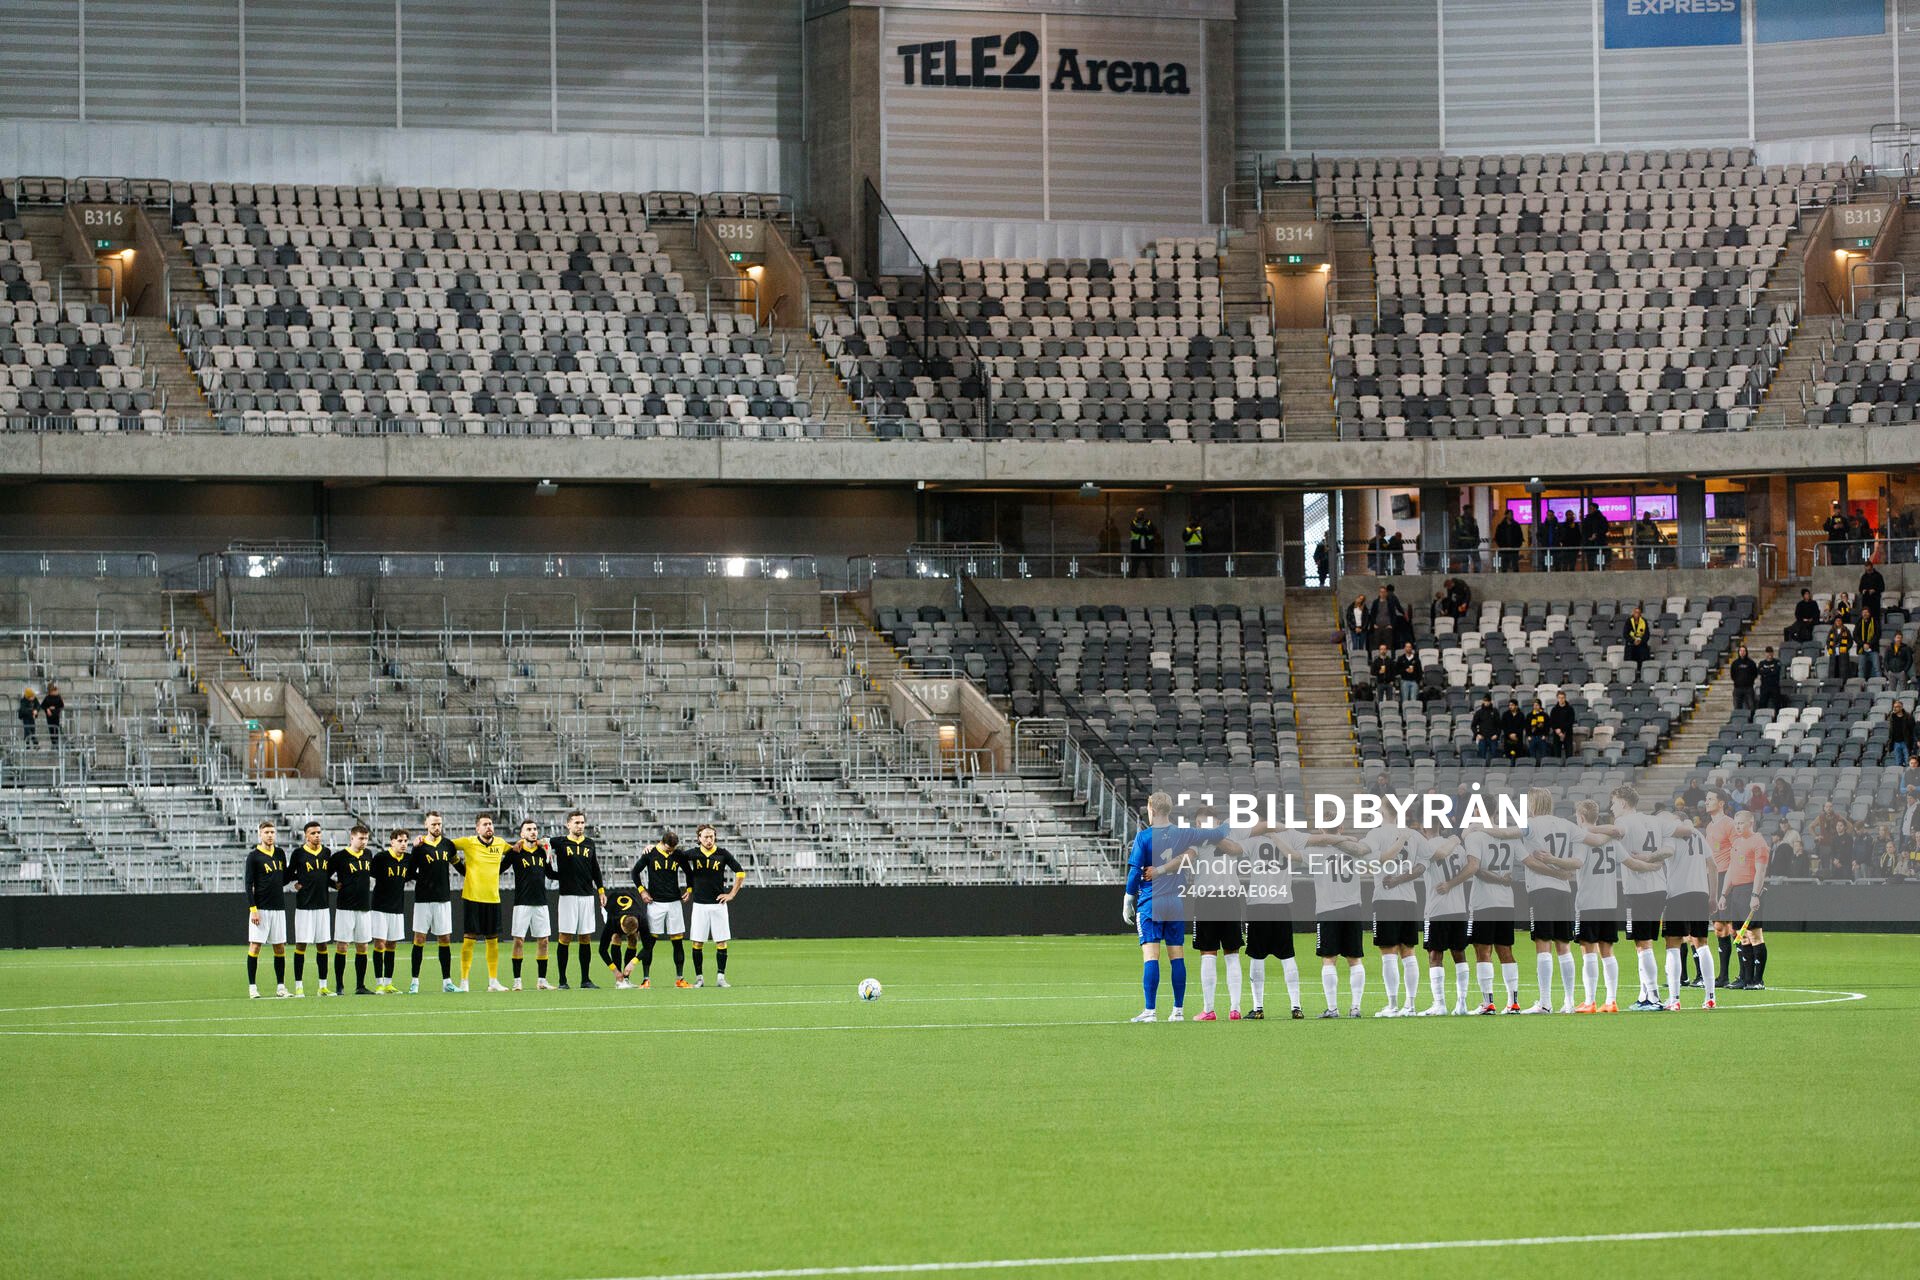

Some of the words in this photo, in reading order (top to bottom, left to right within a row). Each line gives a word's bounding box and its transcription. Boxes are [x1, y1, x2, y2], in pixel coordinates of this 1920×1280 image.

[1627, 0, 1736, 15] EXPRESS
[897, 30, 1041, 89] TELE2
[1050, 48, 1190, 94] Arena
[84, 209, 124, 226] B316
[1844, 208, 1881, 225] B313
[718, 223, 754, 239] B315
[1275, 226, 1314, 241] B314
[230, 686, 273, 703] A116
[910, 684, 949, 700] A115
[1543, 832, 1567, 858] 17
[1642, 830, 1658, 853] 4
[425, 850, 449, 864] AIK
[489, 846, 500, 854] AIK
[566, 845, 590, 858] AIK
[1488, 842, 1511, 871] 22
[263, 860, 284, 874] AIK
[305, 858, 329, 873] AIK
[349, 860, 371, 874] AIK
[521, 856, 544, 868] AIK
[654, 860, 678, 872] AIK
[696, 858, 721, 871] AIK
[1591, 846, 1616, 875] 25
[387, 866, 408, 878] AIK
[616, 895, 633, 911] 9
